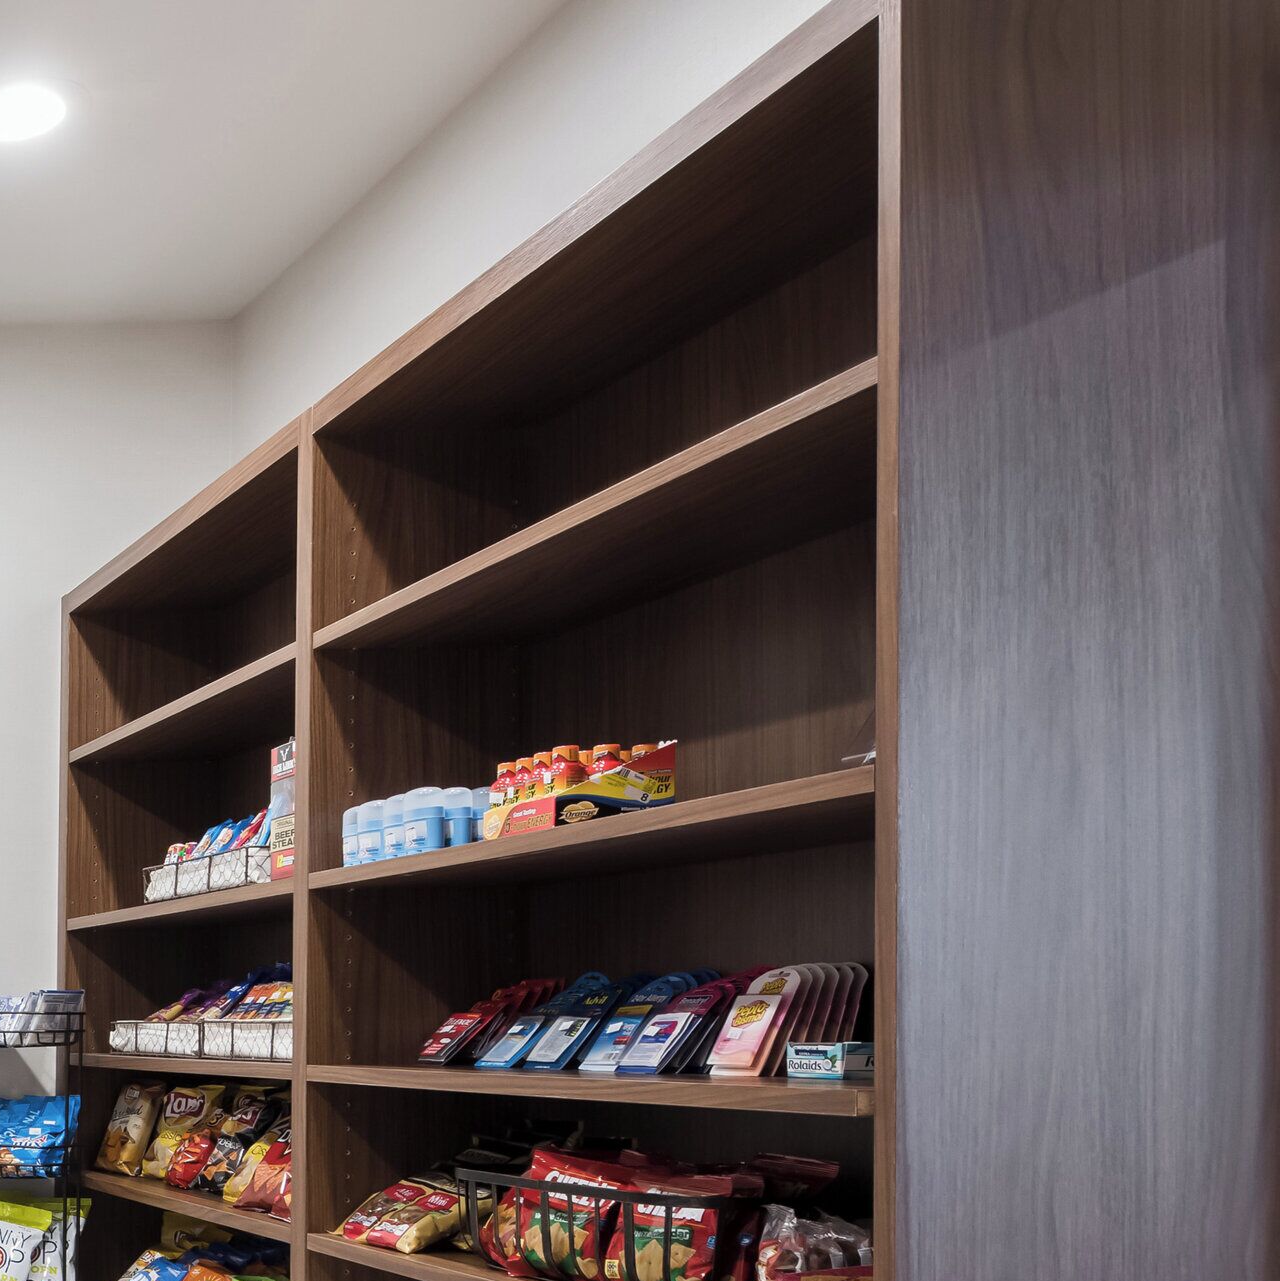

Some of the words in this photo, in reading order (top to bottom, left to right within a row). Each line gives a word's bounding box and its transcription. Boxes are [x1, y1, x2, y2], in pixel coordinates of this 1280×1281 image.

[565, 809, 596, 819] Orange
[272, 838, 294, 849] STEA
[788, 1059, 822, 1071] Rolaids
